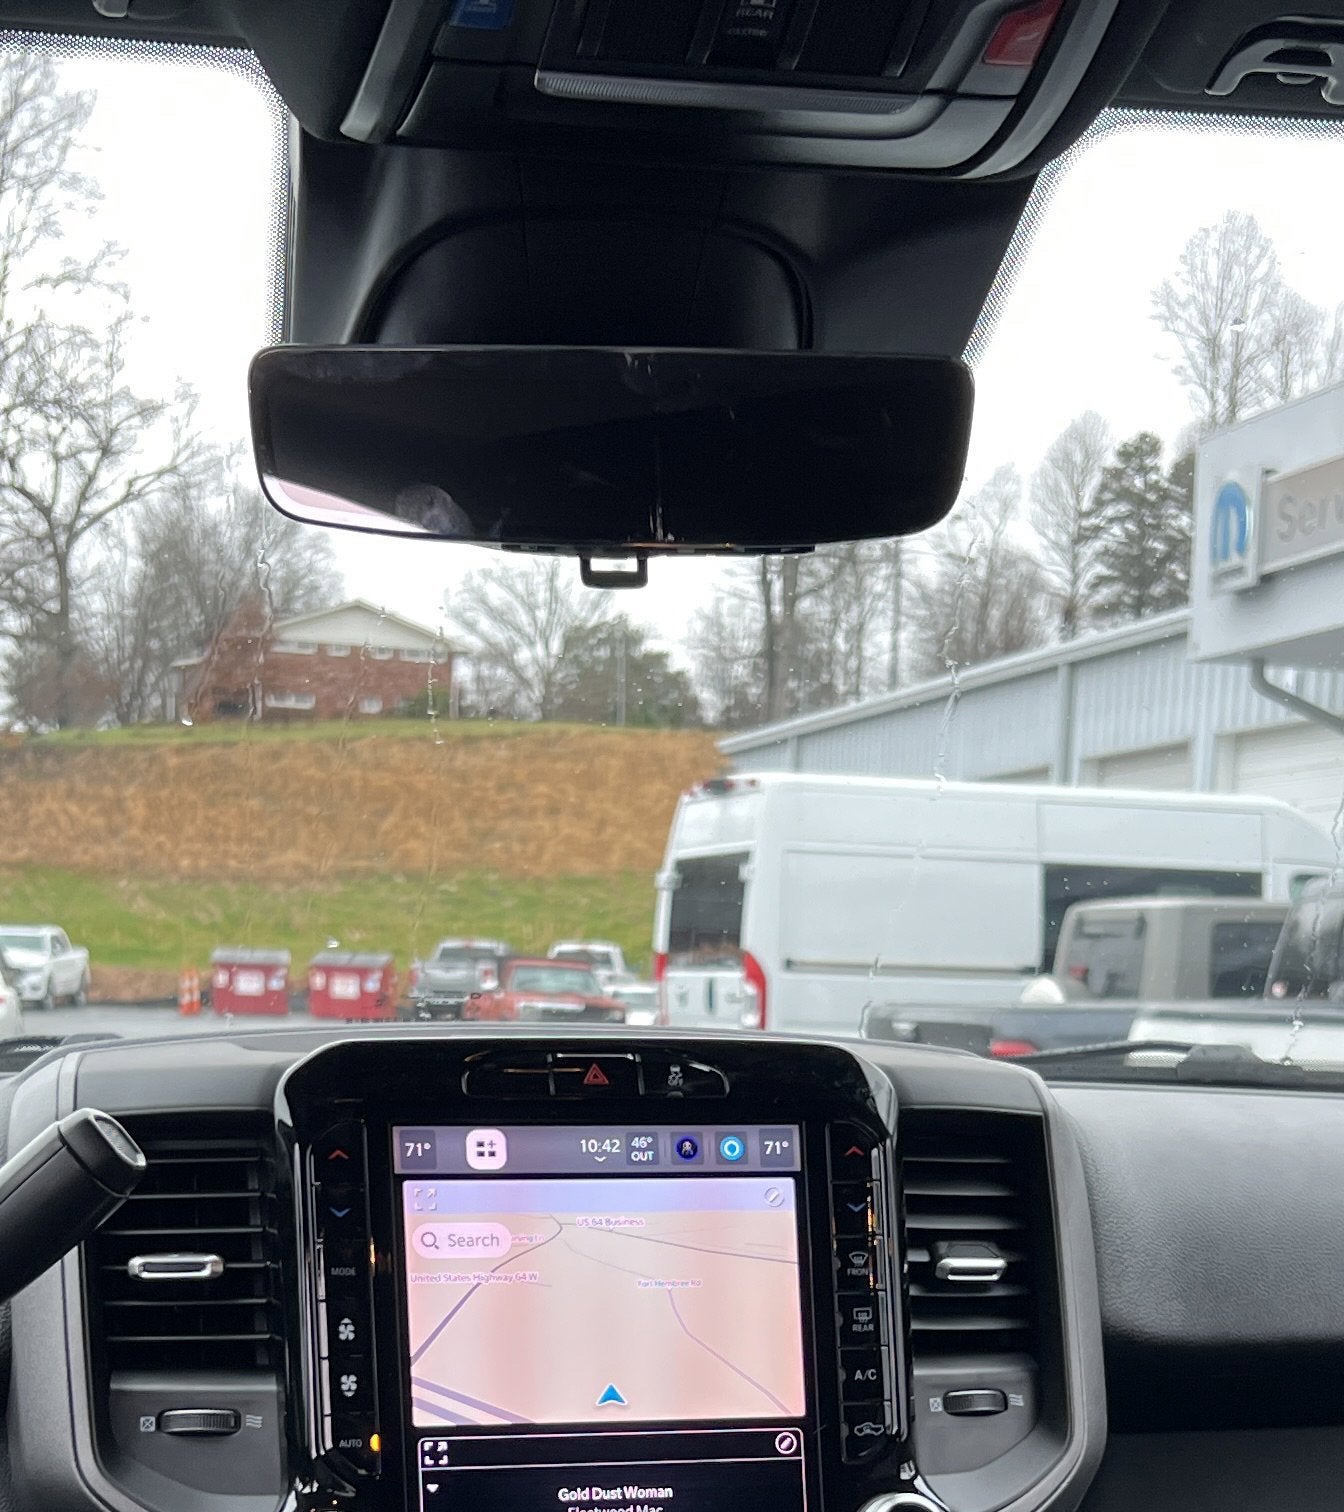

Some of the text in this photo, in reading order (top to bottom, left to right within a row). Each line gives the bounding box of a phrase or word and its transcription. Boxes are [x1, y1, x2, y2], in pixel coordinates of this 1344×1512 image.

[580, 1138, 621, 1153] 10:42
[630, 1150, 655, 1162] OUT
[605, 1217, 644, 1228] Business
[447, 1233, 500, 1248] Search
[331, 1267, 357, 1276] MODE
[411, 1273, 441, 1283] United
[443, 1273, 471, 1282] States
[528, 1271, 538, 1280] W
[852, 1323, 874, 1332] REAR
[854, 1368, 877, 1381] A/C
[339, 1439, 363, 1448] AUTO
[558, 1486, 674, 1501] Gold Dust Woman
